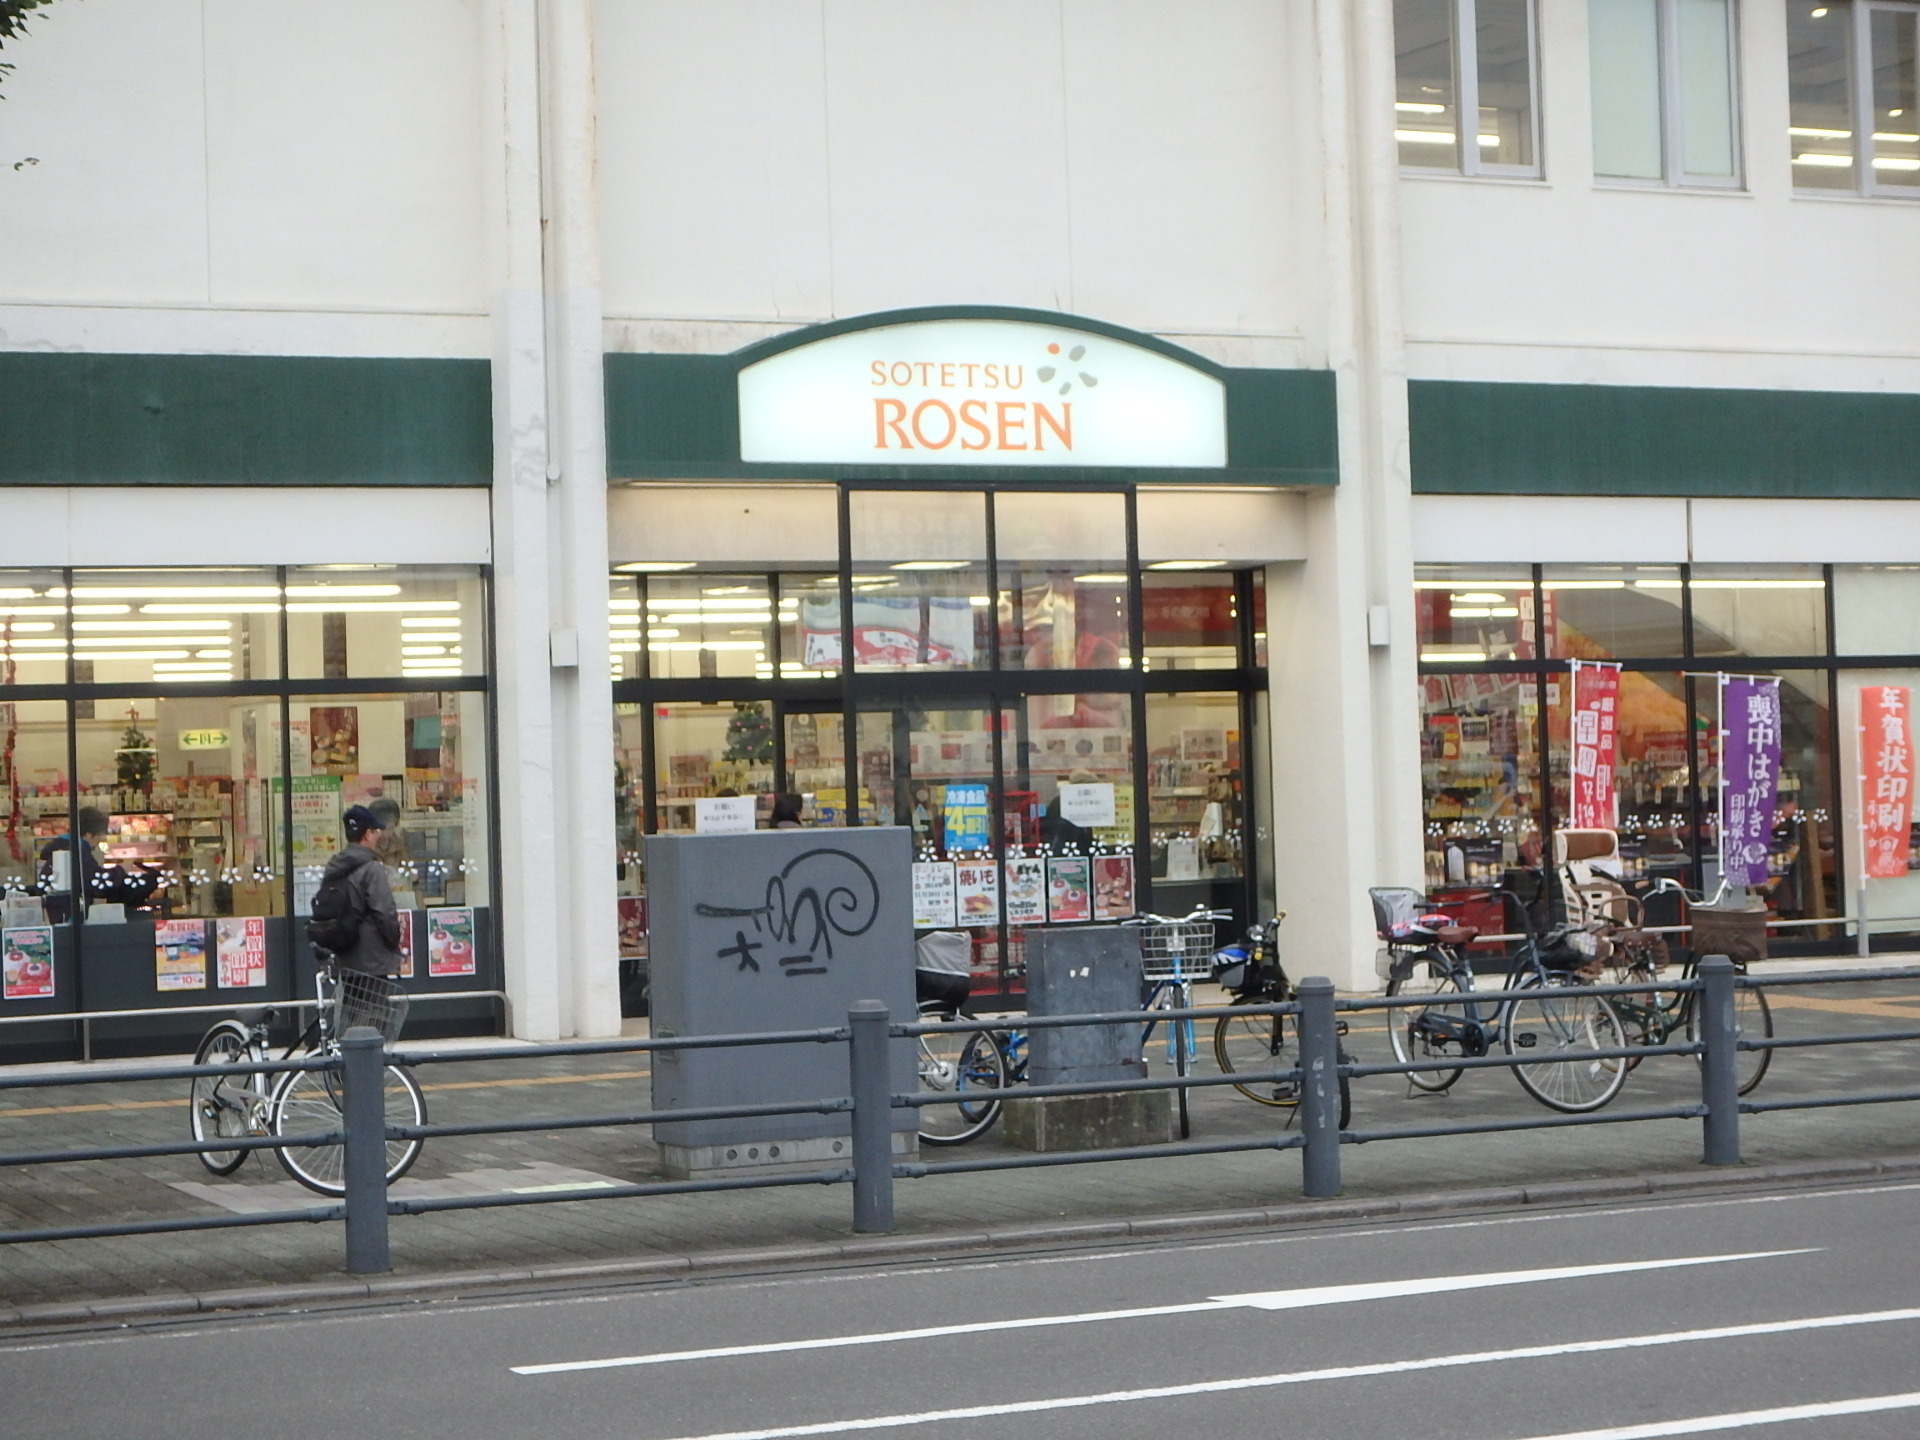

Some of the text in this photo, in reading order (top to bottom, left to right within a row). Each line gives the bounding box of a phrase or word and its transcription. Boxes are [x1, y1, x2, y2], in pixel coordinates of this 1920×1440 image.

[871, 360, 1024, 390] SOTETSU
[873, 398, 1073, 451] ROSEN
[1747, 694, 1774, 838] 喪中はがき
[1876, 686, 1909, 833] 年賀状印刷
[1730, 793, 1746, 870] 印刷承り中
[959, 869, 995, 886] 焼いも
[232, 953, 248, 985] 印刷
[246, 920, 264, 969] 年賀状
